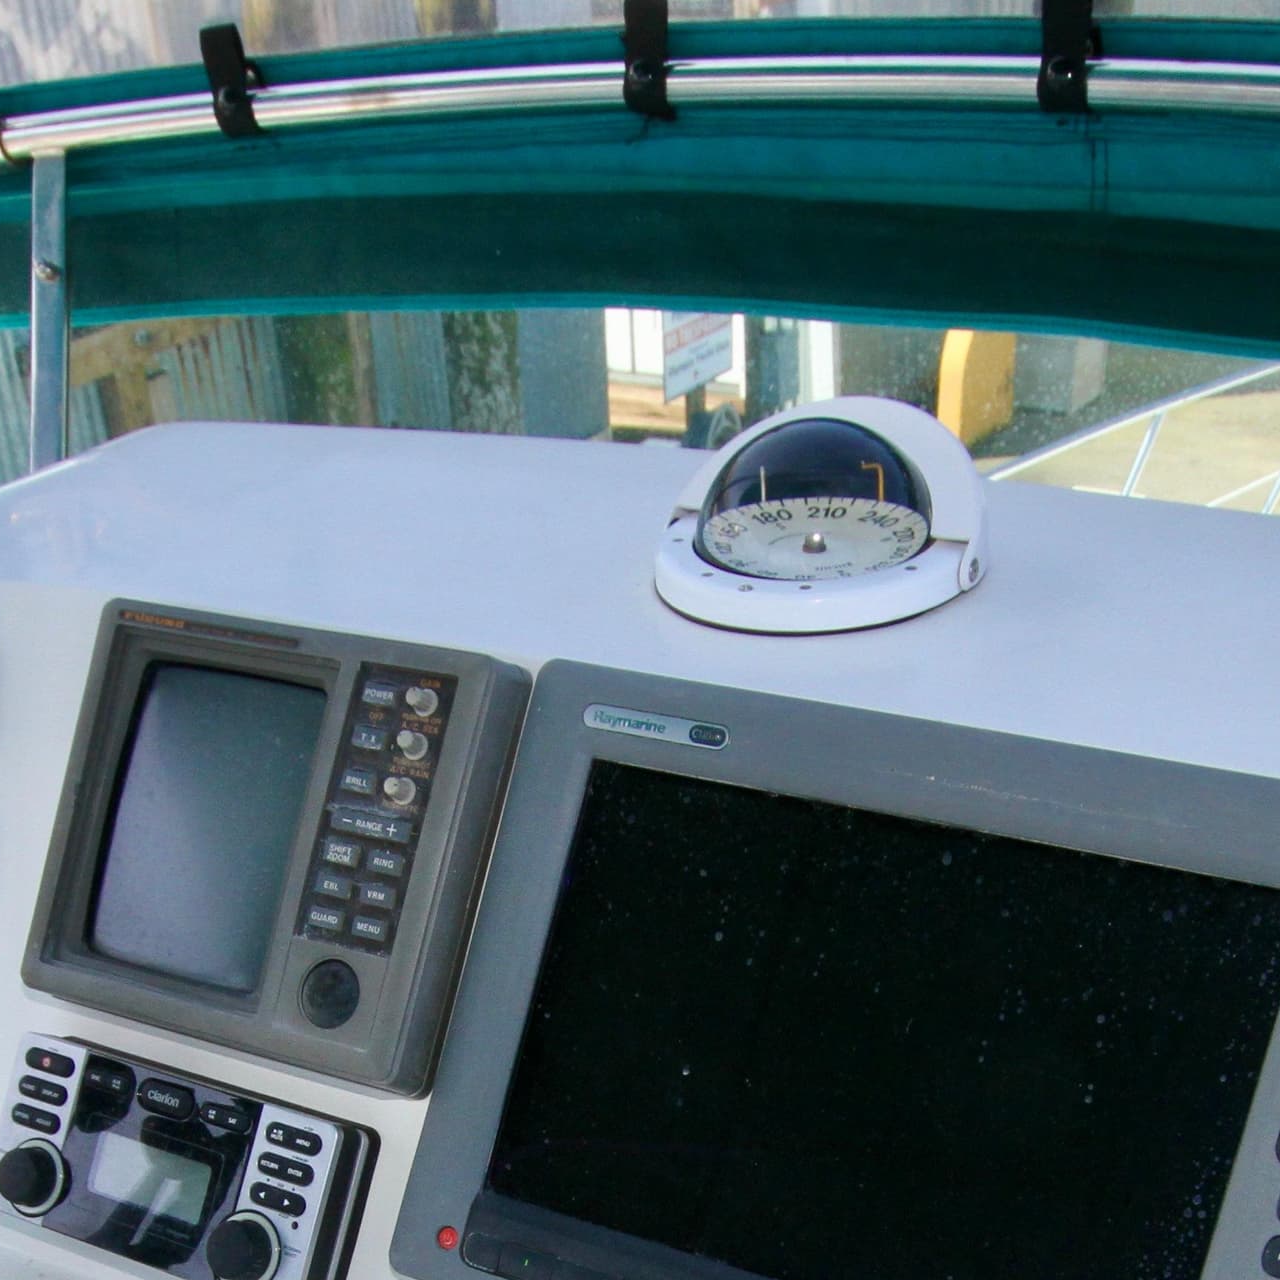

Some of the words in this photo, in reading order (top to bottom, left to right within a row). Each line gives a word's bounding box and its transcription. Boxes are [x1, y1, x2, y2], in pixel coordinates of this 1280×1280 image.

[751, 507, 794, 526] 180
[807, 506, 848, 520] 210
[858, 509, 901, 529] 240
[364, 687, 394, 700] POWER
[593, 709, 668, 735] Raymarine
[355, 818, 384, 833] RANGE
[328, 843, 353, 855] SHIFT
[326, 851, 352, 864] ZOOM
[373, 857, 395, 870] RING
[323, 880, 340, 892] EBL
[367, 889, 385, 901] VRM
[311, 911, 339, 925] GUARD
[356, 921, 382, 935] MENU
[147, 1088, 181, 1109] clarion
